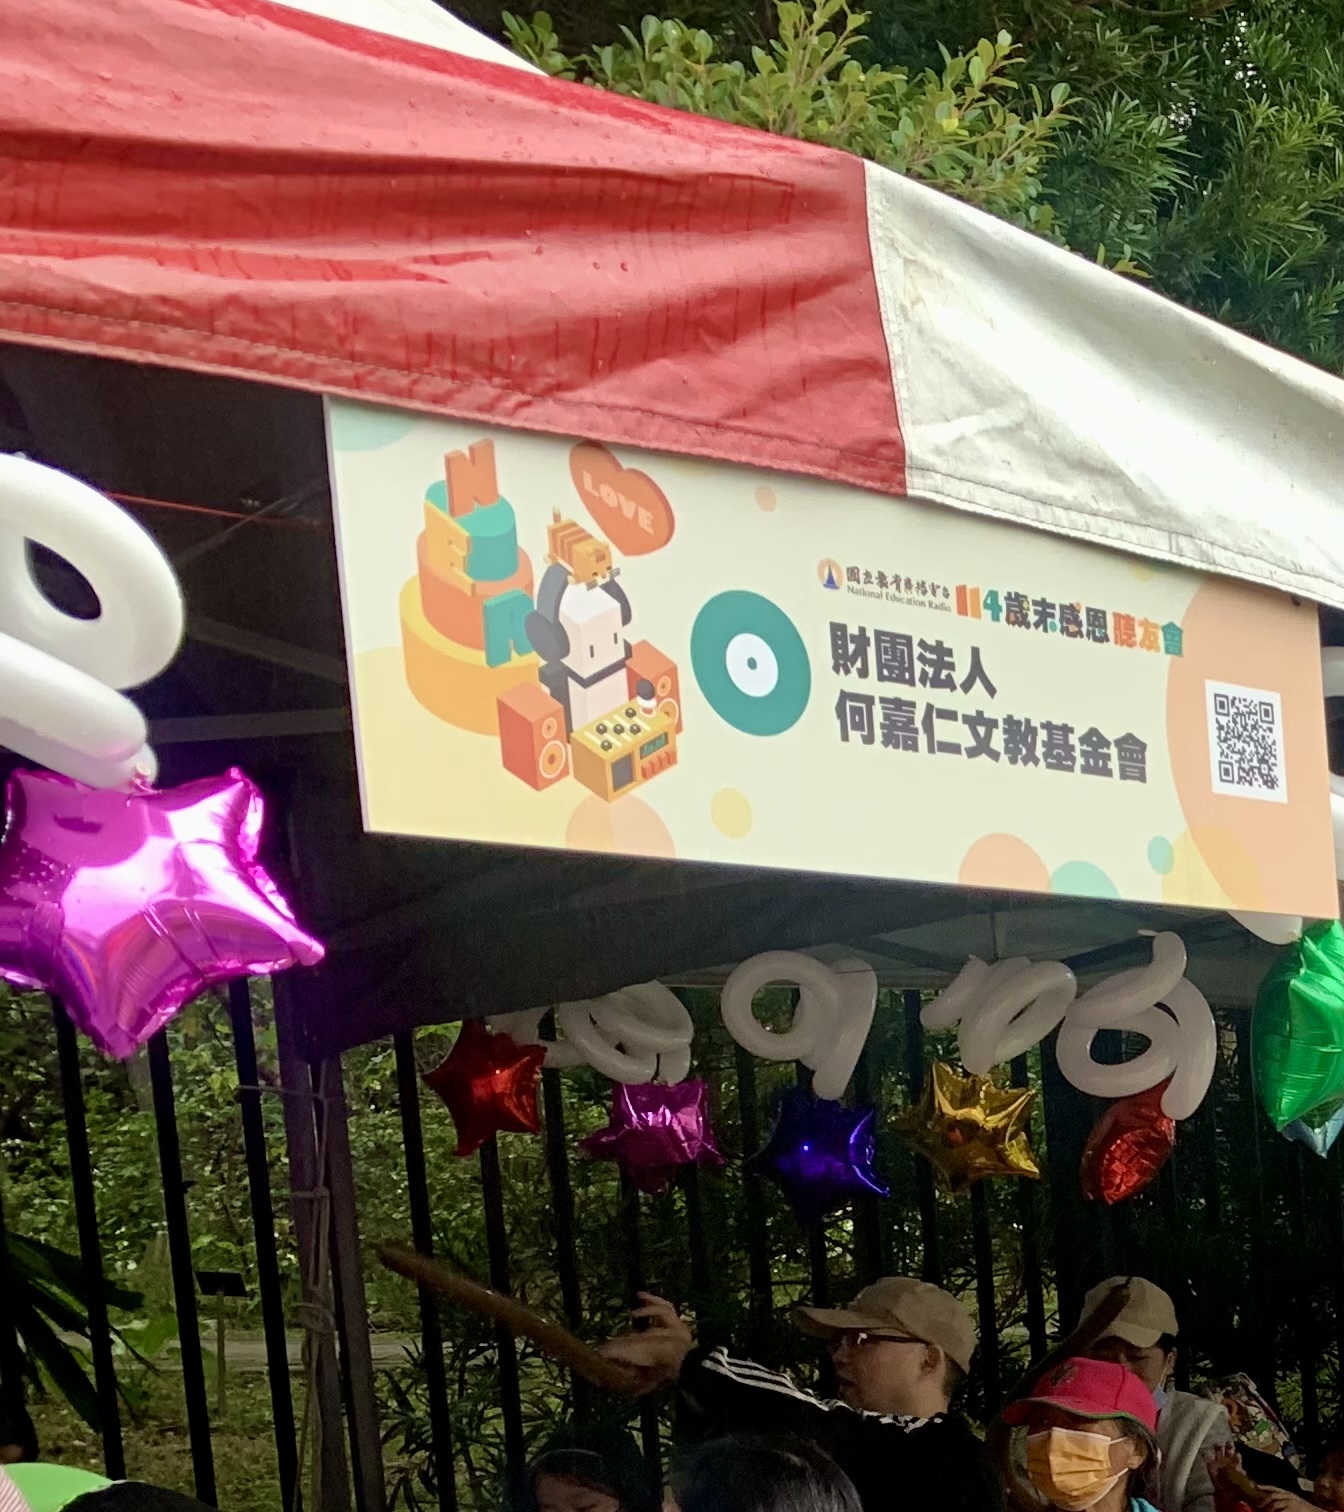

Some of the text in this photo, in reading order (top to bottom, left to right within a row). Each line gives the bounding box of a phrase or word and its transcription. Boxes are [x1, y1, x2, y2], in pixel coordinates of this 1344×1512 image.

[581, 470, 656, 536] LOVE
[846, 584, 951, 613] National Education Radio
[955, 582, 1185, 658] 114歲末感恩聽友會
[829, 621, 998, 699] 財團法人
[835, 689, 1148, 784] 何嘉仁文教基金會
